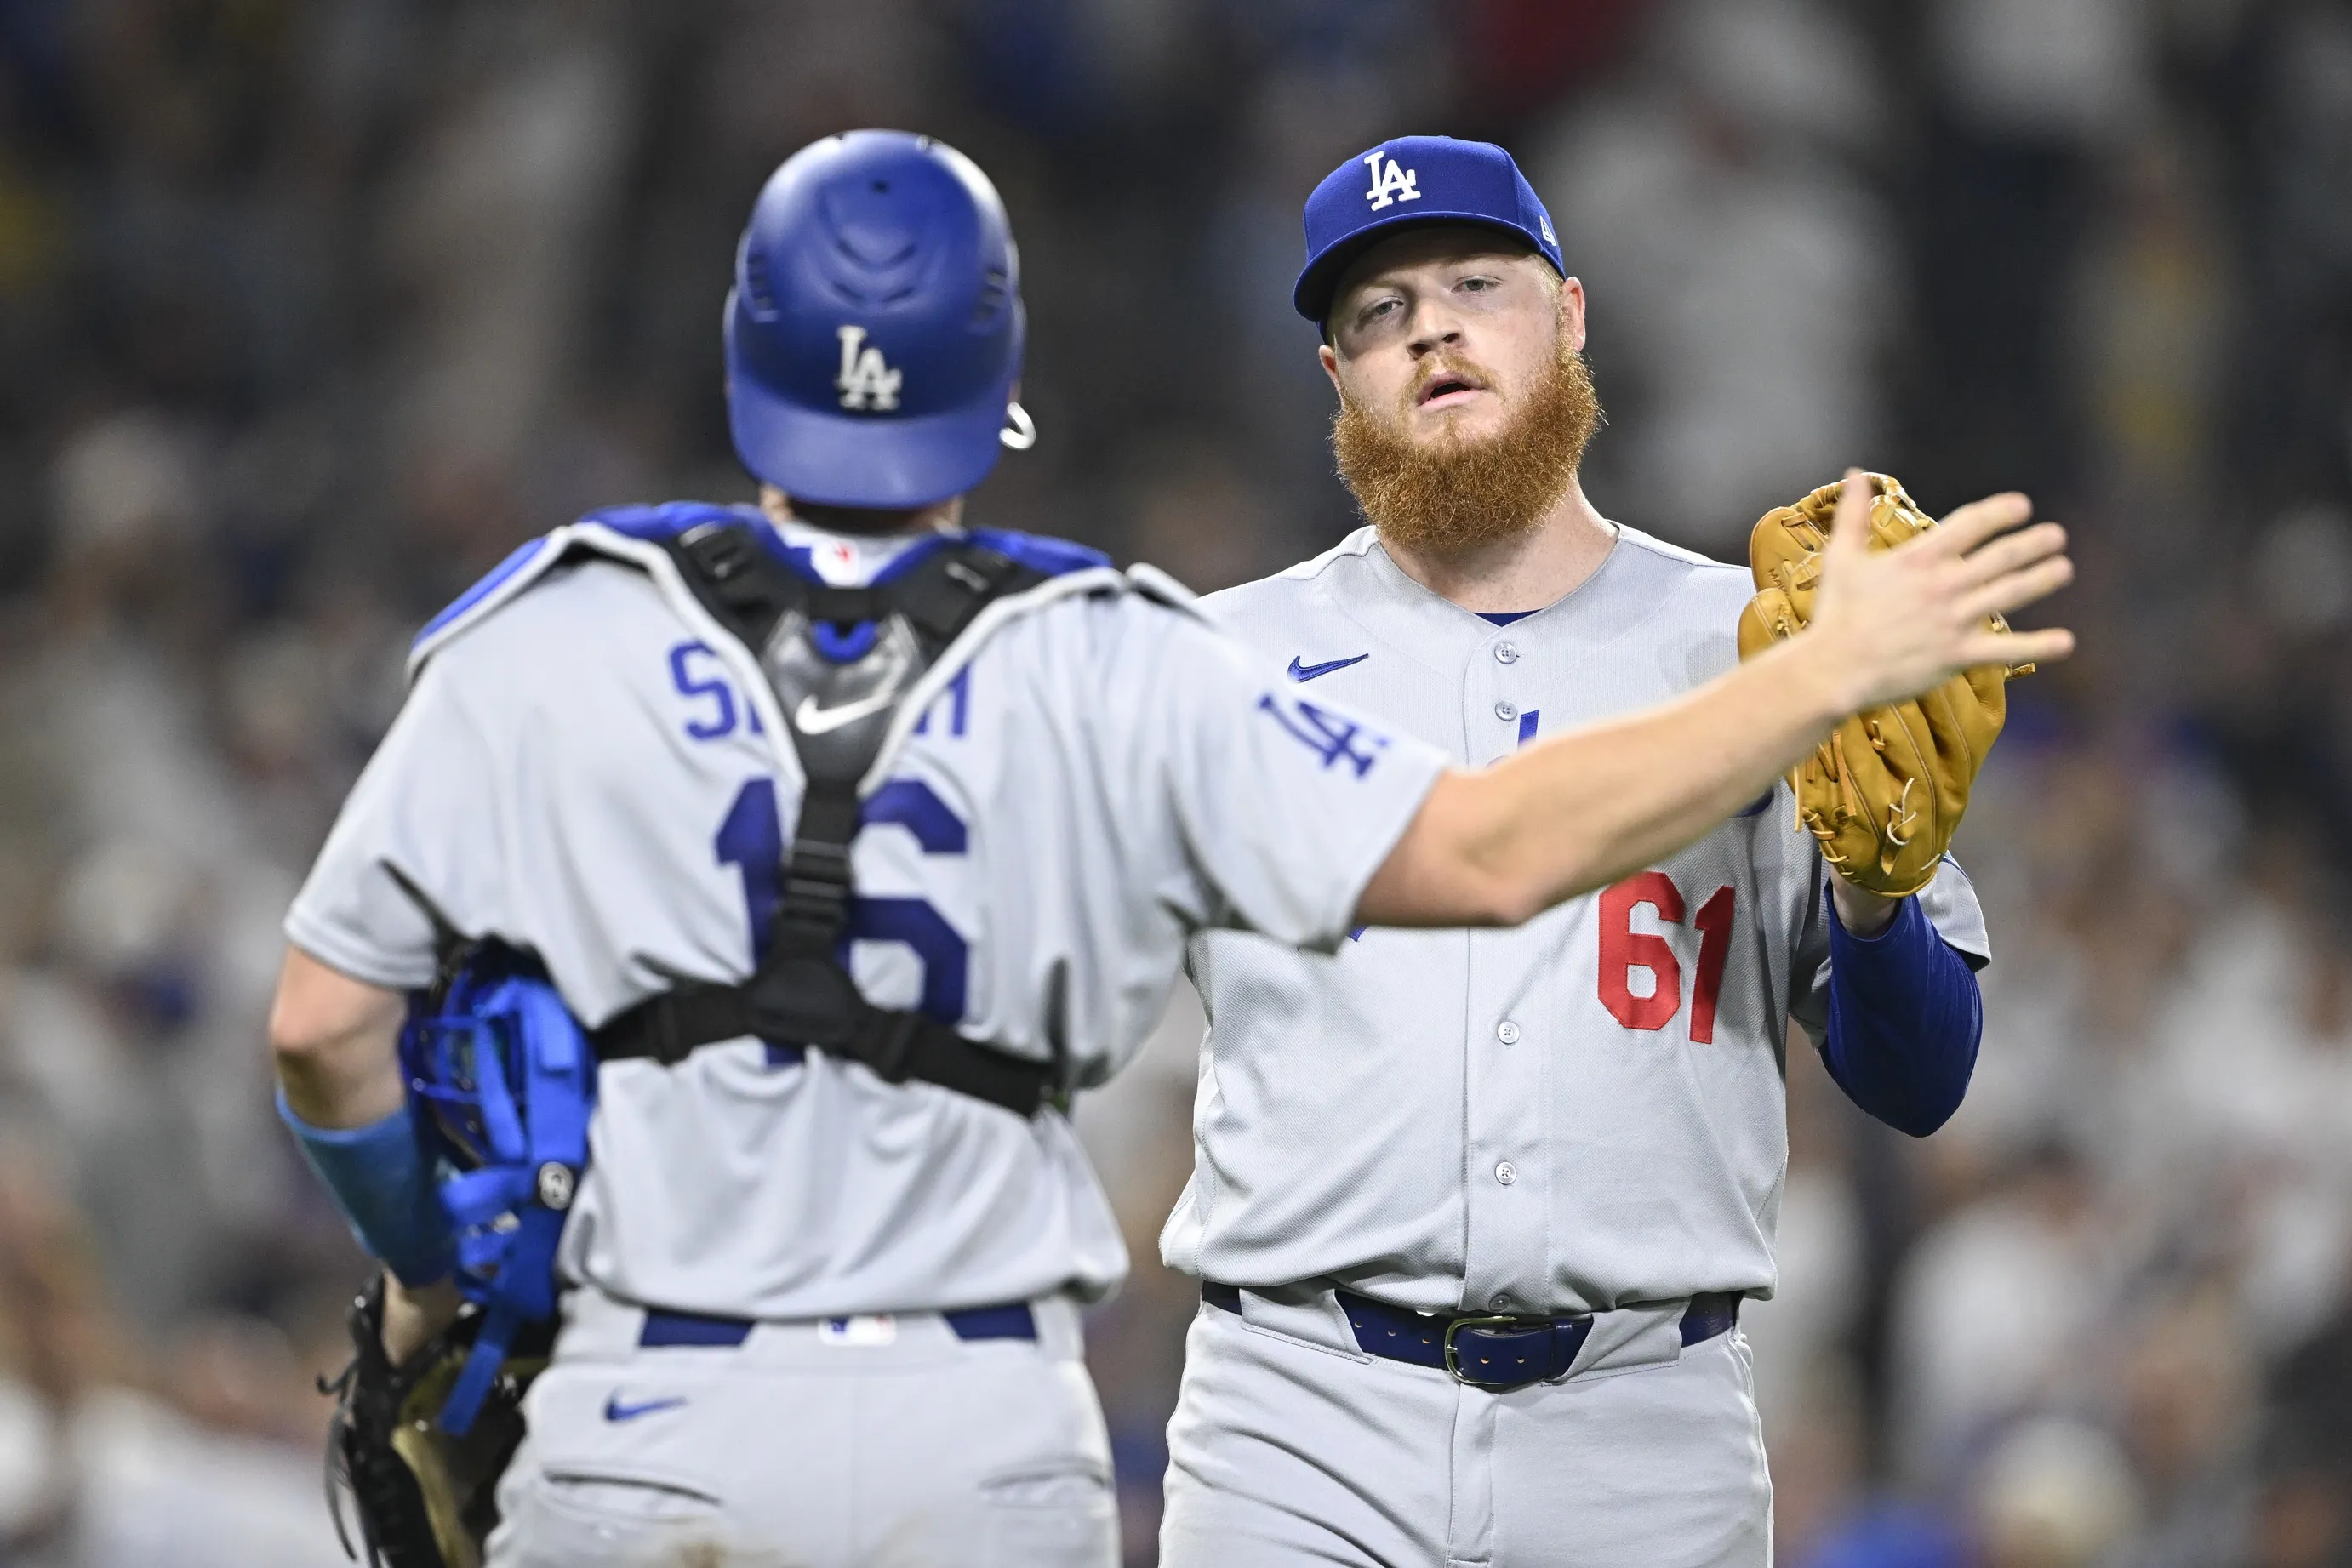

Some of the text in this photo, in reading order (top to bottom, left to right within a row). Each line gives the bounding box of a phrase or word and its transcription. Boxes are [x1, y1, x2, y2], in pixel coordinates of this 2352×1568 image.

[1364, 151, 1421, 211] LA
[836, 325, 902, 410] LA
[1257, 694, 1391, 778] LA
[715, 777, 968, 1067] 16
[1597, 870, 1736, 1045] 61
